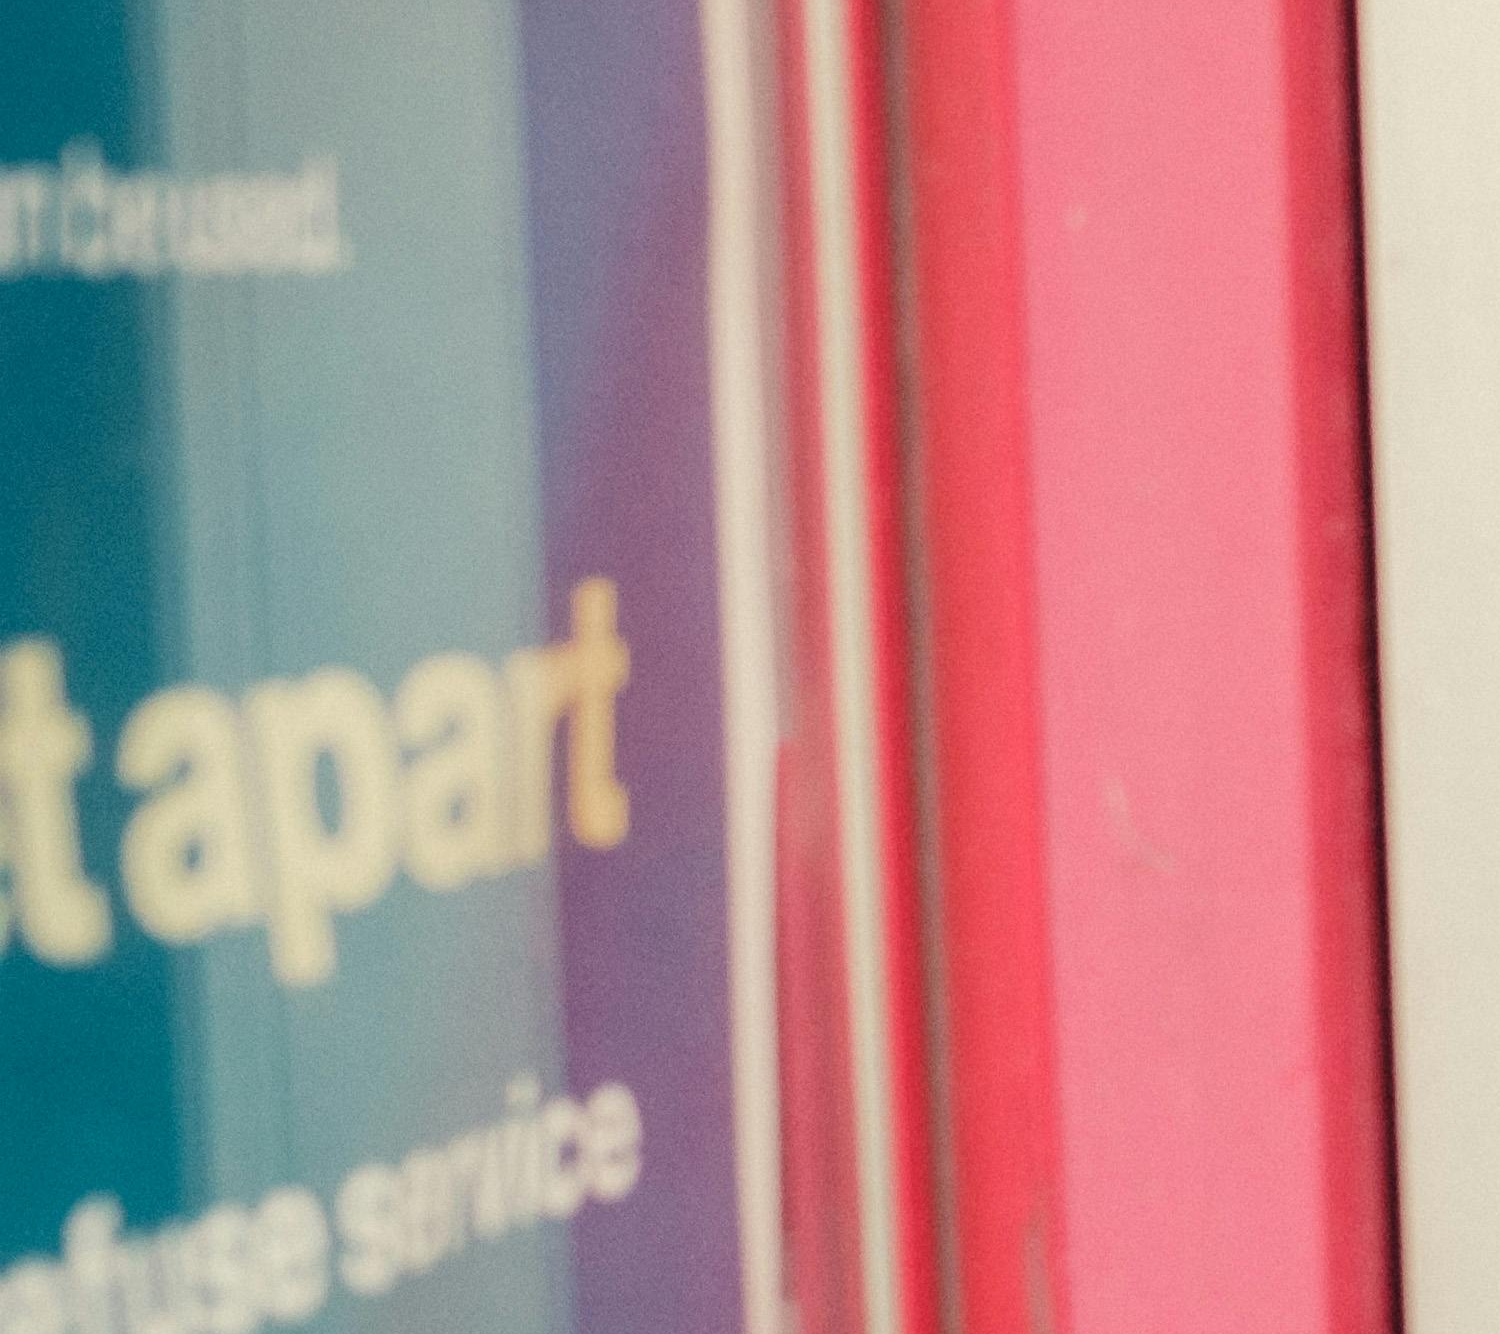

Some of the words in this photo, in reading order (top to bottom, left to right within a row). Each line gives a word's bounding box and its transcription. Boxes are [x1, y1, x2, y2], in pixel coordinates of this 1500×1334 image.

[0, 635, 113, 967] t
[116, 577, 631, 988] apart
[335, 1071, 643, 1297] service
